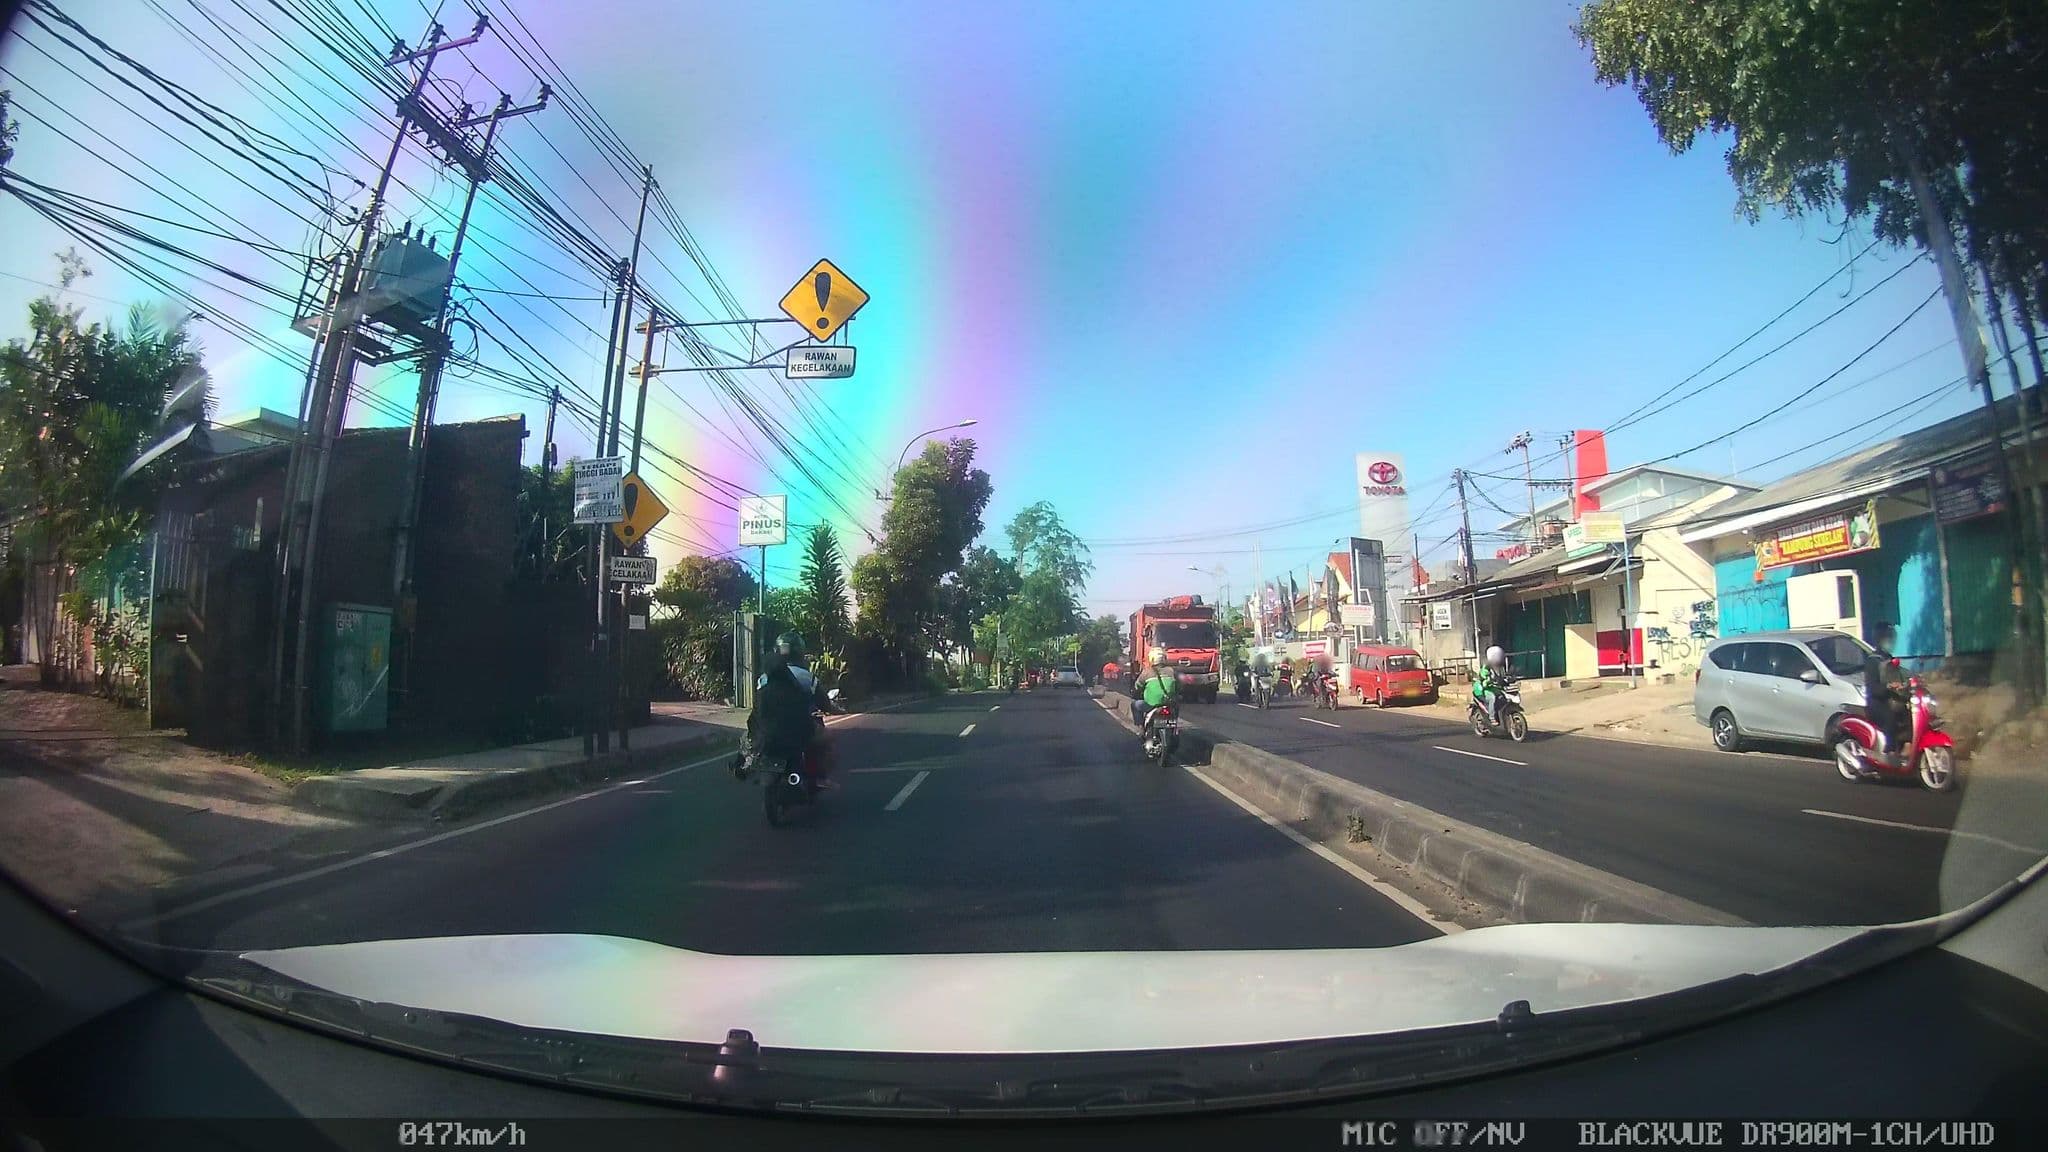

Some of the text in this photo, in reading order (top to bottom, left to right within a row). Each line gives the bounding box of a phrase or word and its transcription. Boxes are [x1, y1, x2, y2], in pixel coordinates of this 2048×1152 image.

[804, 352, 838, 361] RAWAN
[1363, 486, 1406, 496] TOYOTA
[742, 519, 782, 530] PINUS
[614, 560, 645, 569] RAWAN
